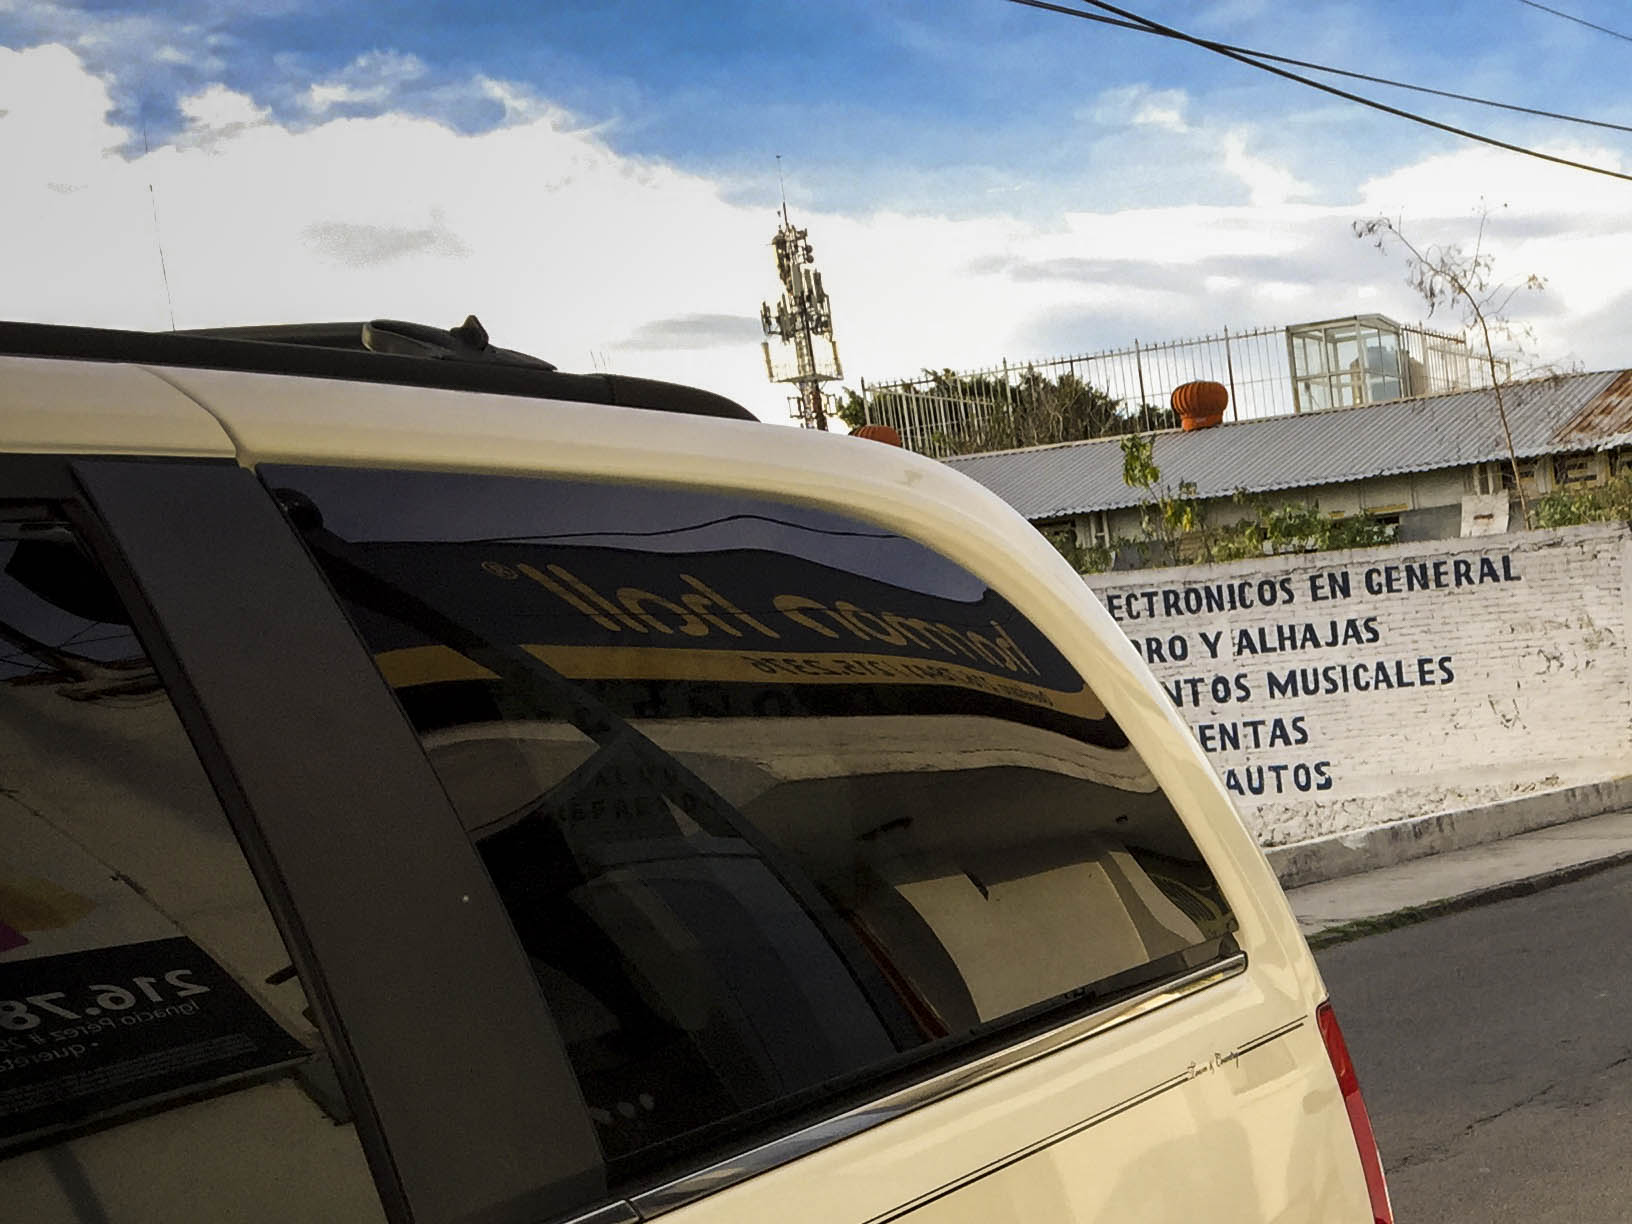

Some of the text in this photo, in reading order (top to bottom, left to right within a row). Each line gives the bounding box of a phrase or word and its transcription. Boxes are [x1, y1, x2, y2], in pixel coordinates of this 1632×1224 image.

[1309, 571, 1350, 601] EN
[1364, 554, 1522, 595] GENERAL
[1199, 631, 1223, 659] Y
[1237, 616, 1380, 657] ALHAJAS
[1267, 656, 1455, 699] MUSICALES
[1199, 716, 1309, 752] ENTAS
[1226, 761, 1333, 796] AUTOS
